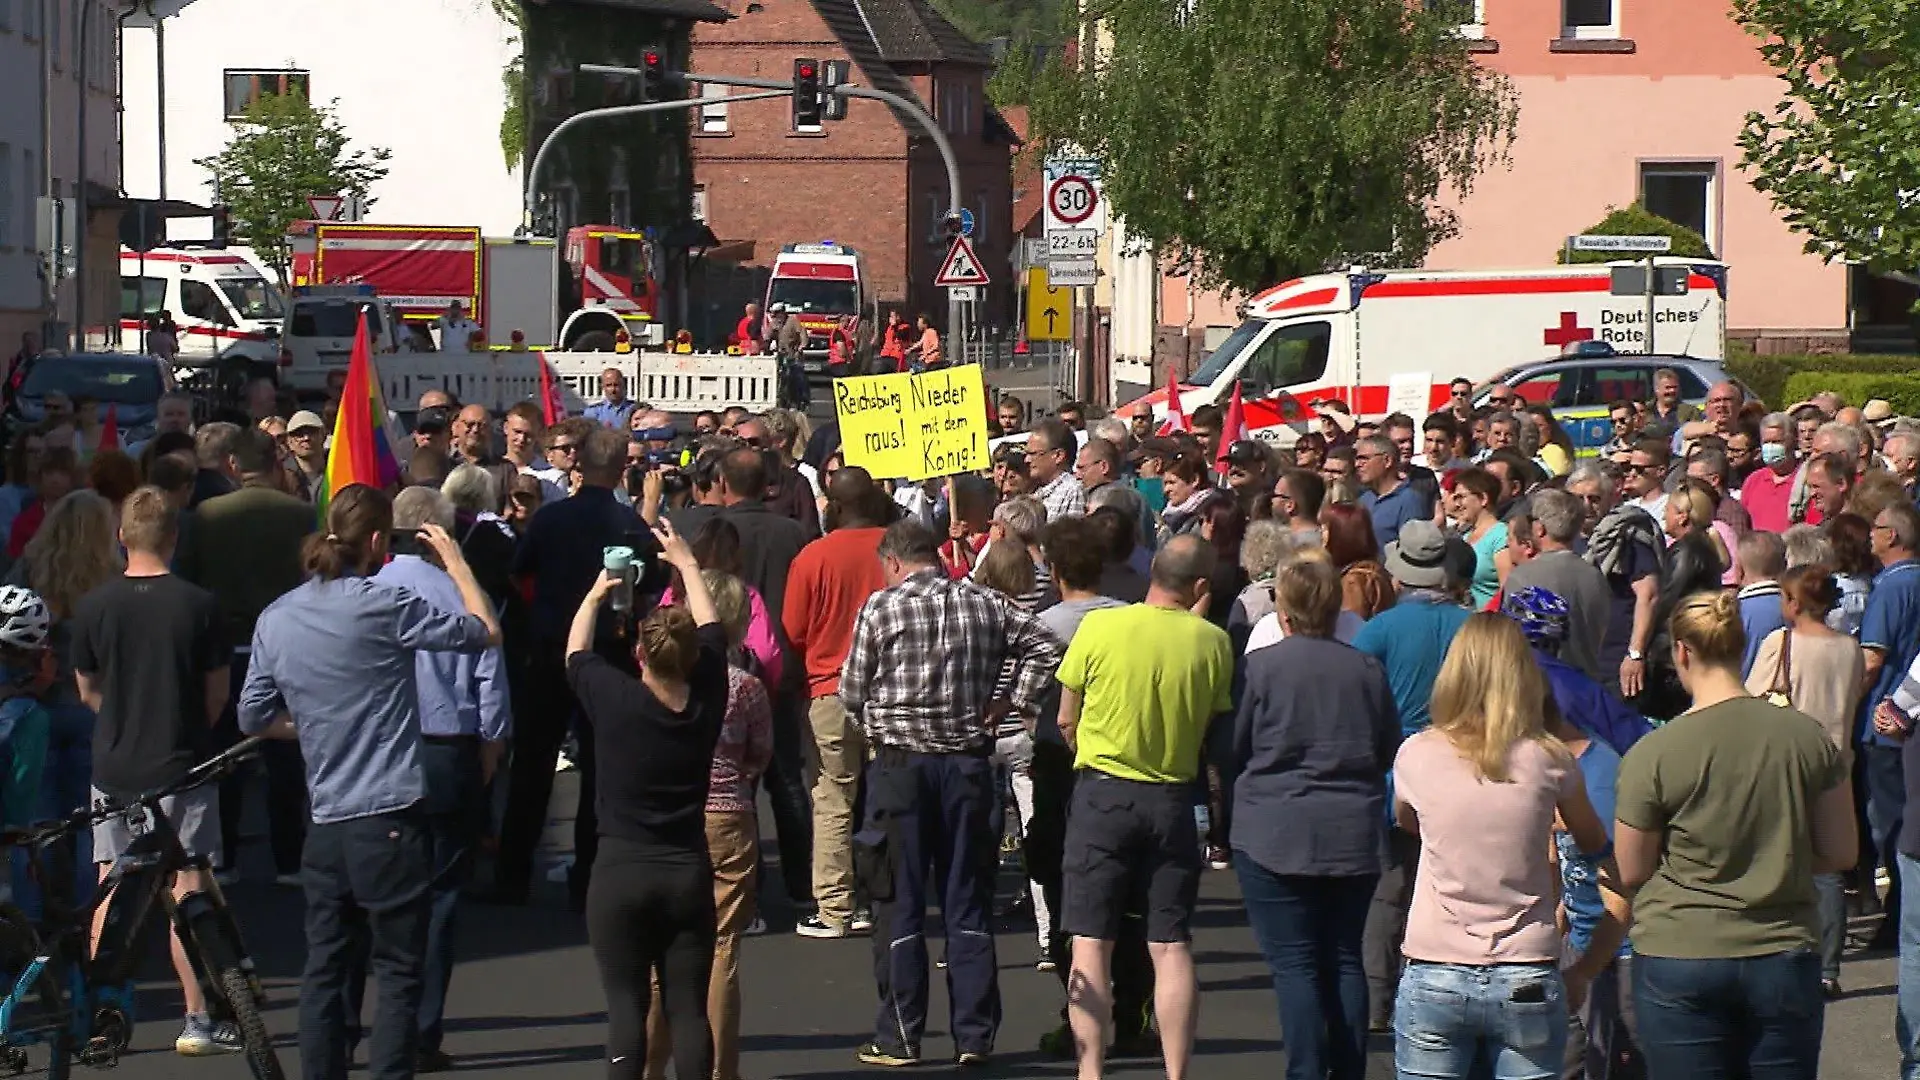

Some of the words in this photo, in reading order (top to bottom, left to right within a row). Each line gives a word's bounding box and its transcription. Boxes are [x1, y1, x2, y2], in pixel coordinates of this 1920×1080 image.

[1059, 189, 1087, 211] 30
[1602, 308, 1699, 325] Deutches
[910, 373, 967, 412] Nieder
[921, 415, 939, 436] mit
[944, 410, 967, 431] dem
[865, 418, 906, 455] raus!
